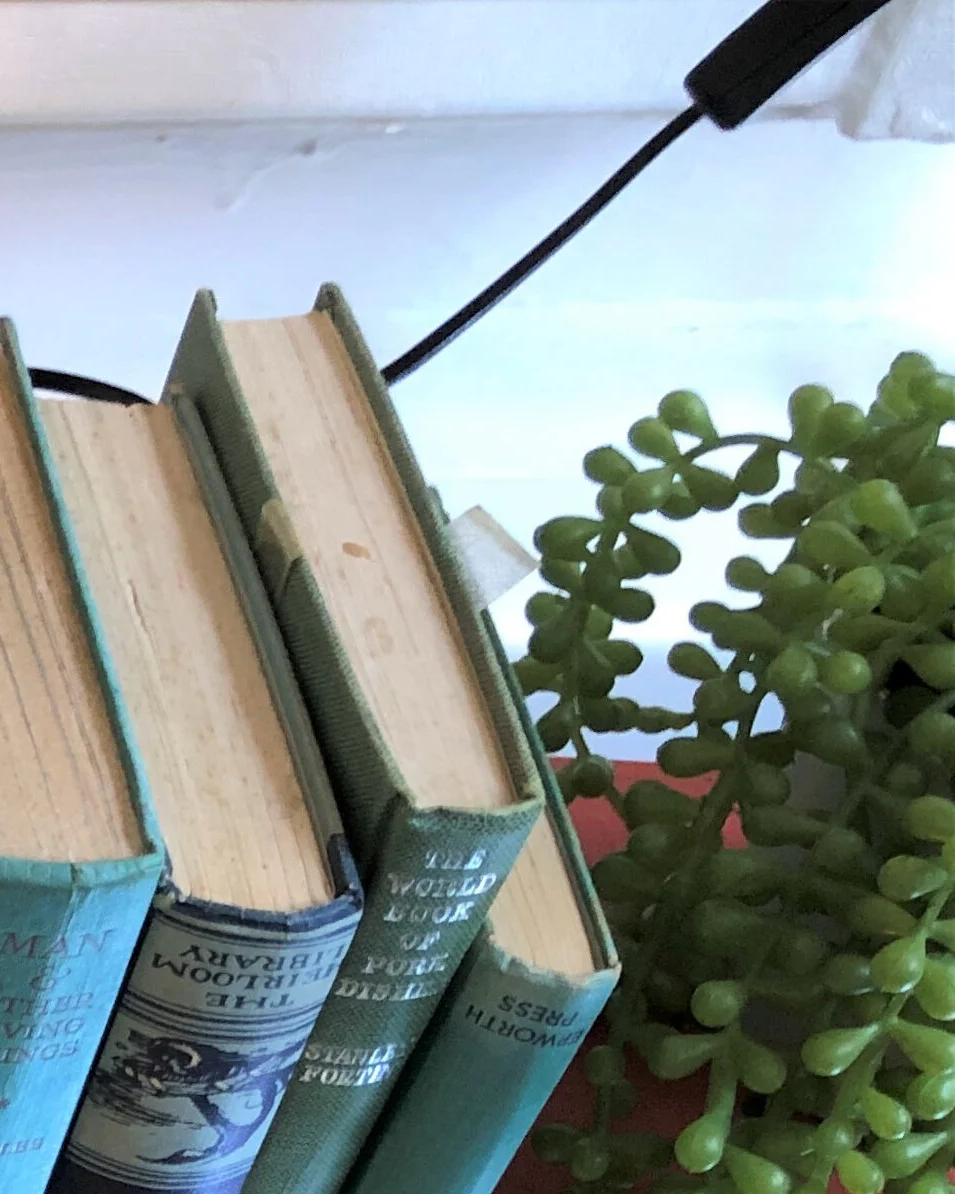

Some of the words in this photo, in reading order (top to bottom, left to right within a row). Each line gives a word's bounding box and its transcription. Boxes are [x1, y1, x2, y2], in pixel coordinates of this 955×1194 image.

[0, 929, 118, 959] MAN
[180, 943, 347, 972] LIBRARY
[30, 964, 71, 992] &
[205, 992, 294, 1010] THE
[498, 994, 579, 1026] PRESS
[465, 1004, 585, 1047] EPWORTH
